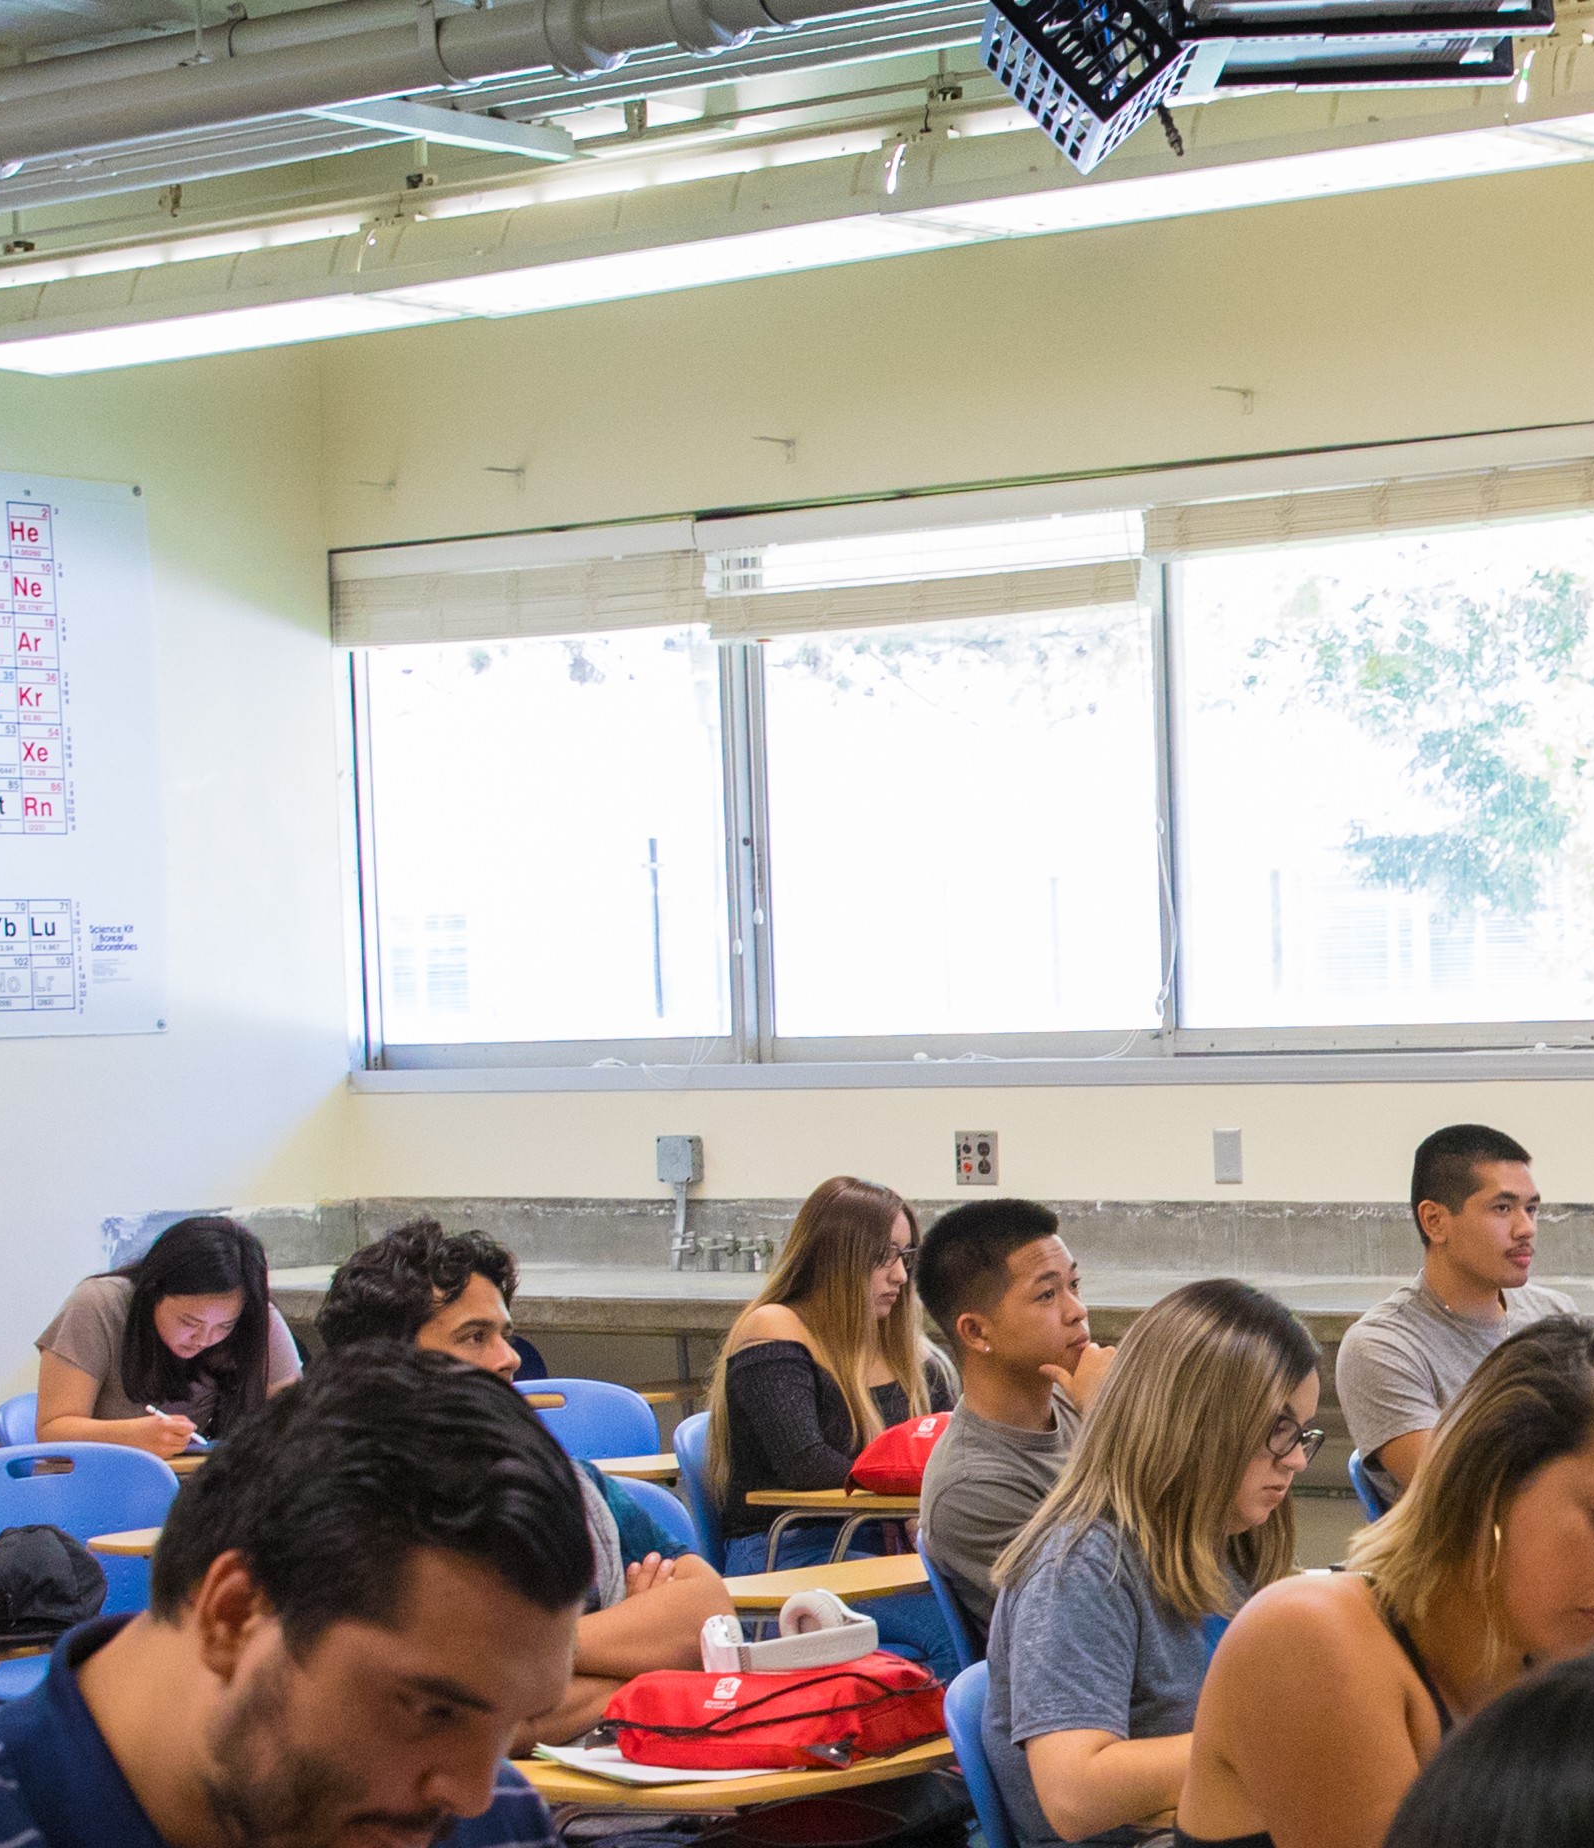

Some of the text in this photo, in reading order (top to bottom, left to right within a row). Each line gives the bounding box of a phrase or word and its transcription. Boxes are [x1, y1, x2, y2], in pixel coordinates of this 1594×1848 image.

[10, 521, 39, 543] He
[13, 577, 42, 597] Ne
[18, 632, 41, 652] Ar
[19, 687, 42, 707] Kr
[22, 742, 48, 762] Xe
[25, 798, 52, 816] Rn
[31, 917, 56, 936] Lu
